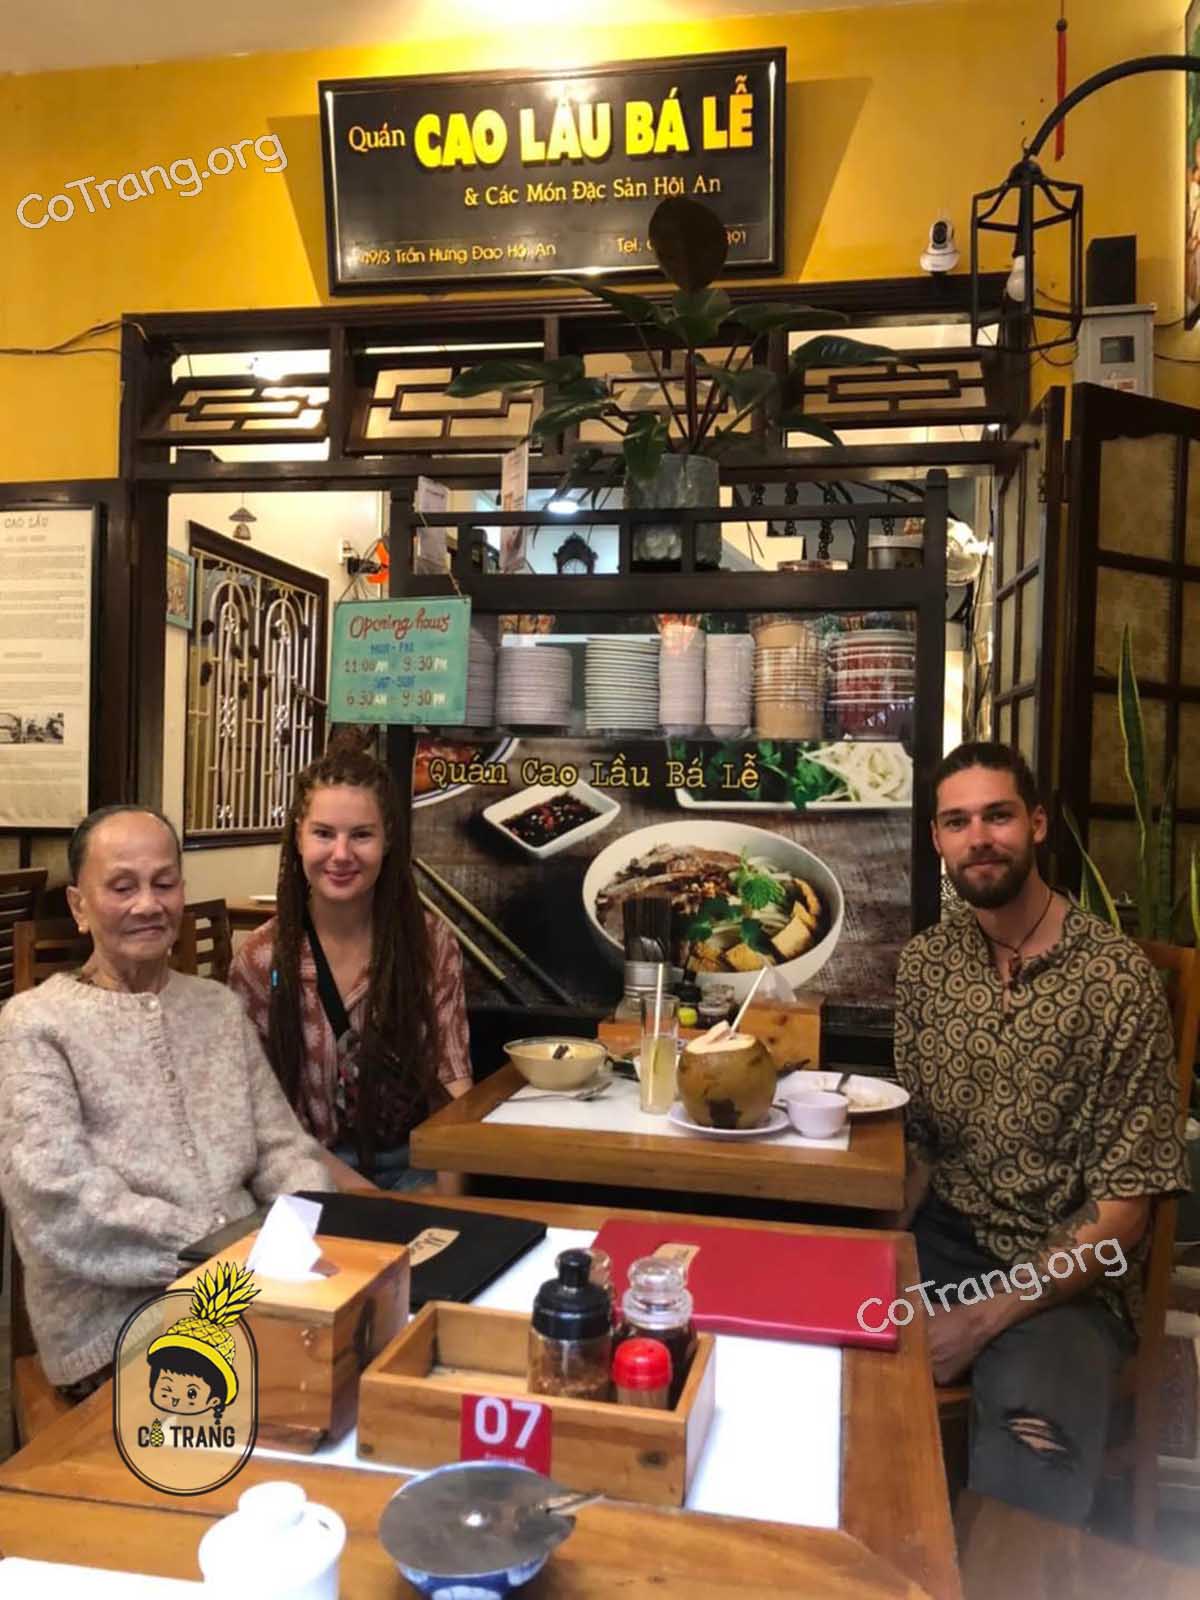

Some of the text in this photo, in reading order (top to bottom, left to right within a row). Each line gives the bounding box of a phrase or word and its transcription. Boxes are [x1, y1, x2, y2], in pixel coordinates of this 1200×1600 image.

[347, 122, 406, 152] Quán
[414, 108, 508, 168] CAO
[625, 87, 690, 156] BÁ
[703, 74, 754, 150] LỄ
[464, 187, 479, 206] &
[485, 184, 519, 205] Các
[526, 181, 567, 203] Món
[571, 180, 607, 203] Đặc
[613, 175, 648, 198] Sản
[693, 175, 721, 194] An
[350, 614, 413, 641] Opening
[428, 753, 760, 790] Quán Cao Lầu Bá Lễ
[474, 1396, 543, 1450] 07
